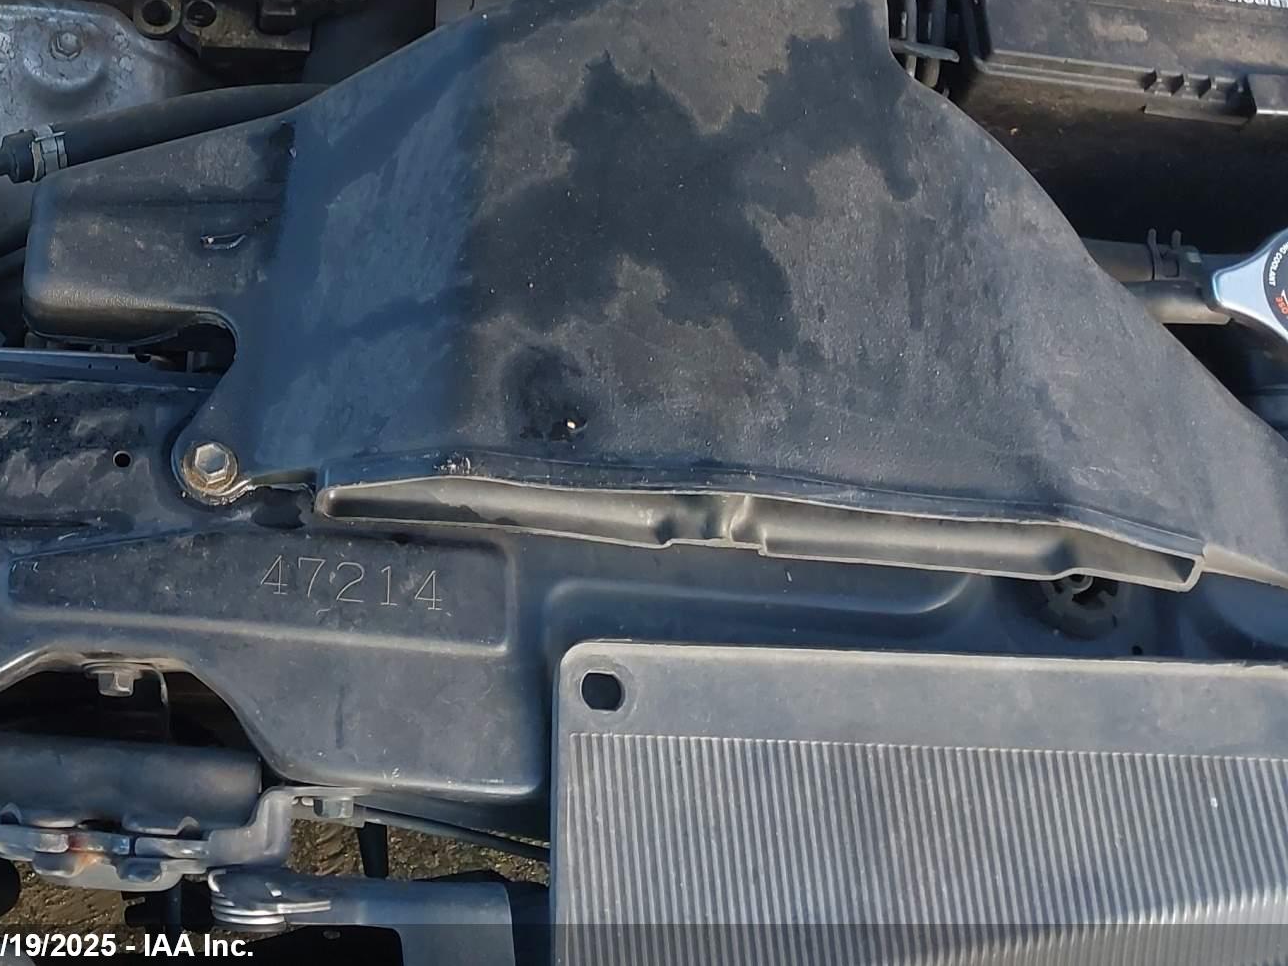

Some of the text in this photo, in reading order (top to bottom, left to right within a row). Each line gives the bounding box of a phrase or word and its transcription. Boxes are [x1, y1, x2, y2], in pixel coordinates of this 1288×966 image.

[1269, 253, 1283, 286] COOLANT
[1276, 297, 1288, 314] OSE
[261, 555, 443, 611] 47214
